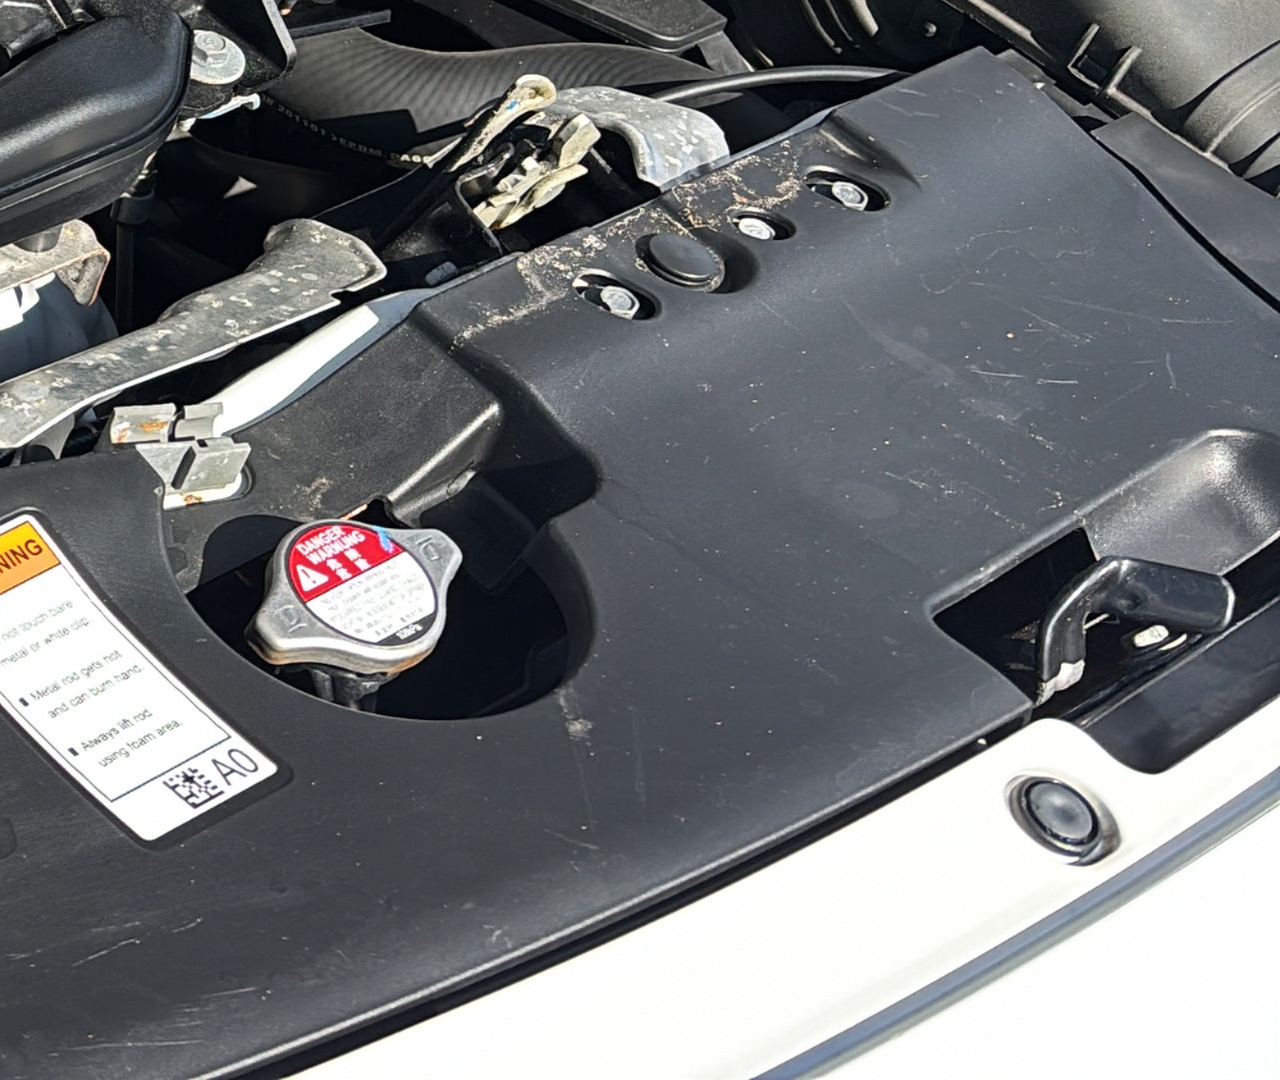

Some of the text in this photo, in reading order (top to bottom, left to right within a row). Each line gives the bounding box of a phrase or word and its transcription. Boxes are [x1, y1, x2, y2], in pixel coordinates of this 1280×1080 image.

[295, 525, 343, 557] DANGER
[306, 530, 366, 566] WARNUNG
[2, 627, 20, 642] not
[20, 609, 49, 632] touch
[49, 599, 73, 618] bare
[0, 647, 29, 667] metal
[30, 641, 41, 653] or
[43, 626, 70, 645] white
[30, 650, 122, 701] Metal rod gets hot
[48, 664, 145, 718] and can burn hand.
[81, 708, 153, 752] Always lift rod
[98, 718, 184, 768] using foam area.
